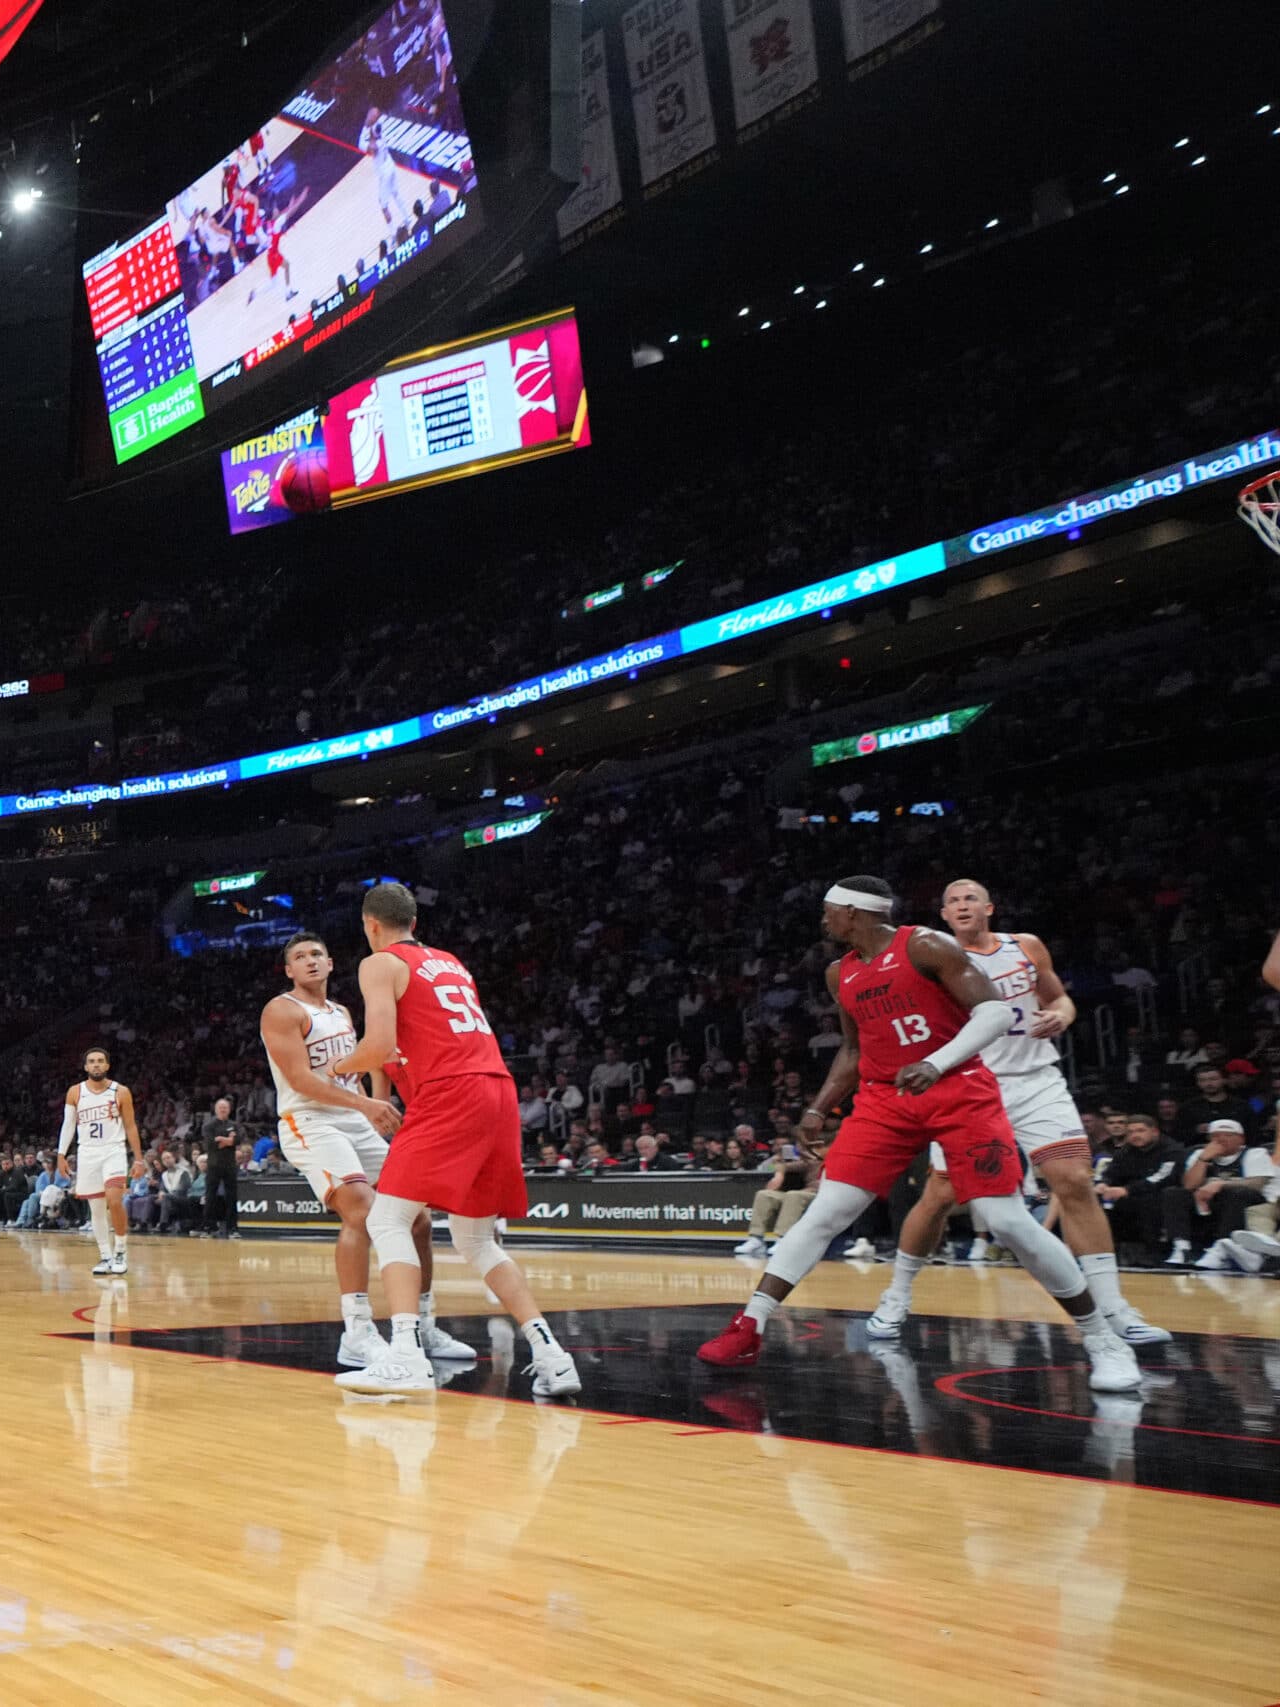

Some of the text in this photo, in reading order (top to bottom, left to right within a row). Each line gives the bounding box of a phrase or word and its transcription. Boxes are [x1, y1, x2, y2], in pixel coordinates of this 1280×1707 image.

[416, 125, 472, 172] HEA
[147, 383, 195, 412] Baptist
[151, 400, 195, 432] Health
[231, 423, 315, 465] INTENSITY
[231, 473, 270, 514] Takis
[969, 435, 1280, 554] Game-changing health
[433, 583, 850, 731] Game-changing health solutions Florida Blue
[16, 739, 360, 812] Game-changing health solutions Florida Blue
[891, 1014, 932, 1046] 13
[90, 1122, 103, 1139] 21
[237, 1200, 268, 1213] KIA
[276, 1200, 295, 1213] The
[295, 1201, 320, 1213] 2025
[582, 1203, 661, 1220] Movement
[663, 1203, 696, 1220] that
[698, 1203, 754, 1224] inspire
